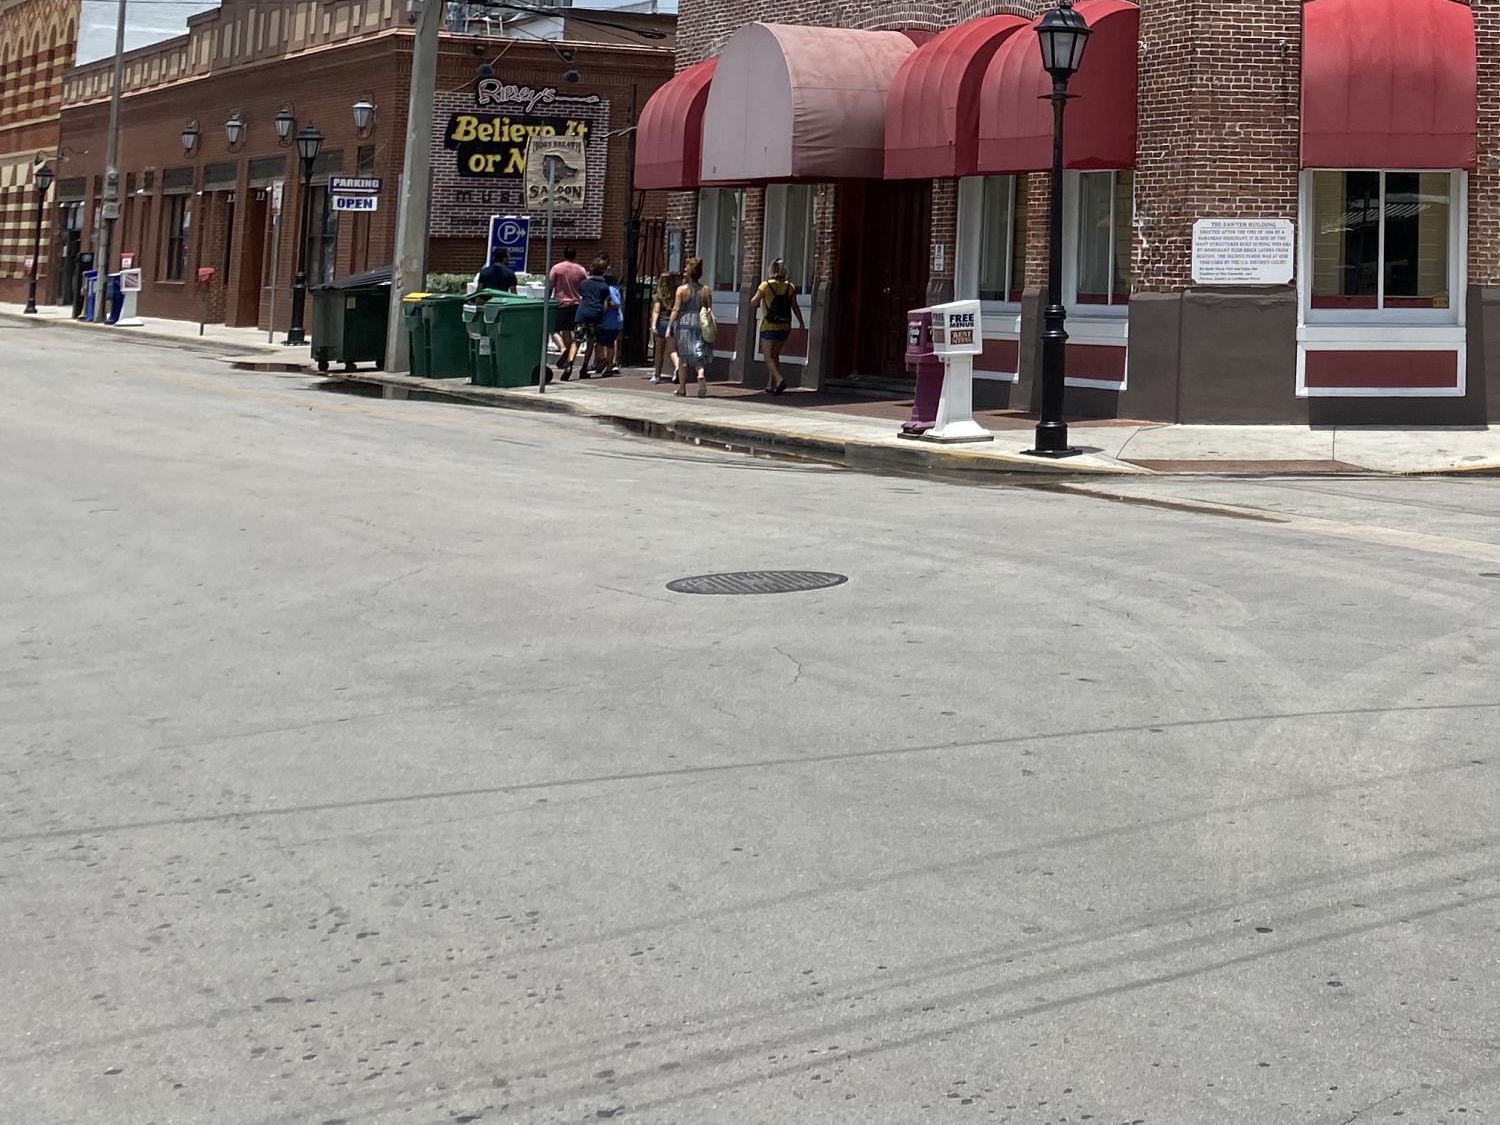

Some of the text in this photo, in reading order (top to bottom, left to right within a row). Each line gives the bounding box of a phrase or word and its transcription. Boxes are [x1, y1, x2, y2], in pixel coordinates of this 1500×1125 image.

[468, 153, 501, 173] or
[333, 178, 379, 188] PARKING
[529, 185, 582, 198] SAOON
[337, 198, 373, 209] OPEN
[949, 314, 974, 323] FREE
